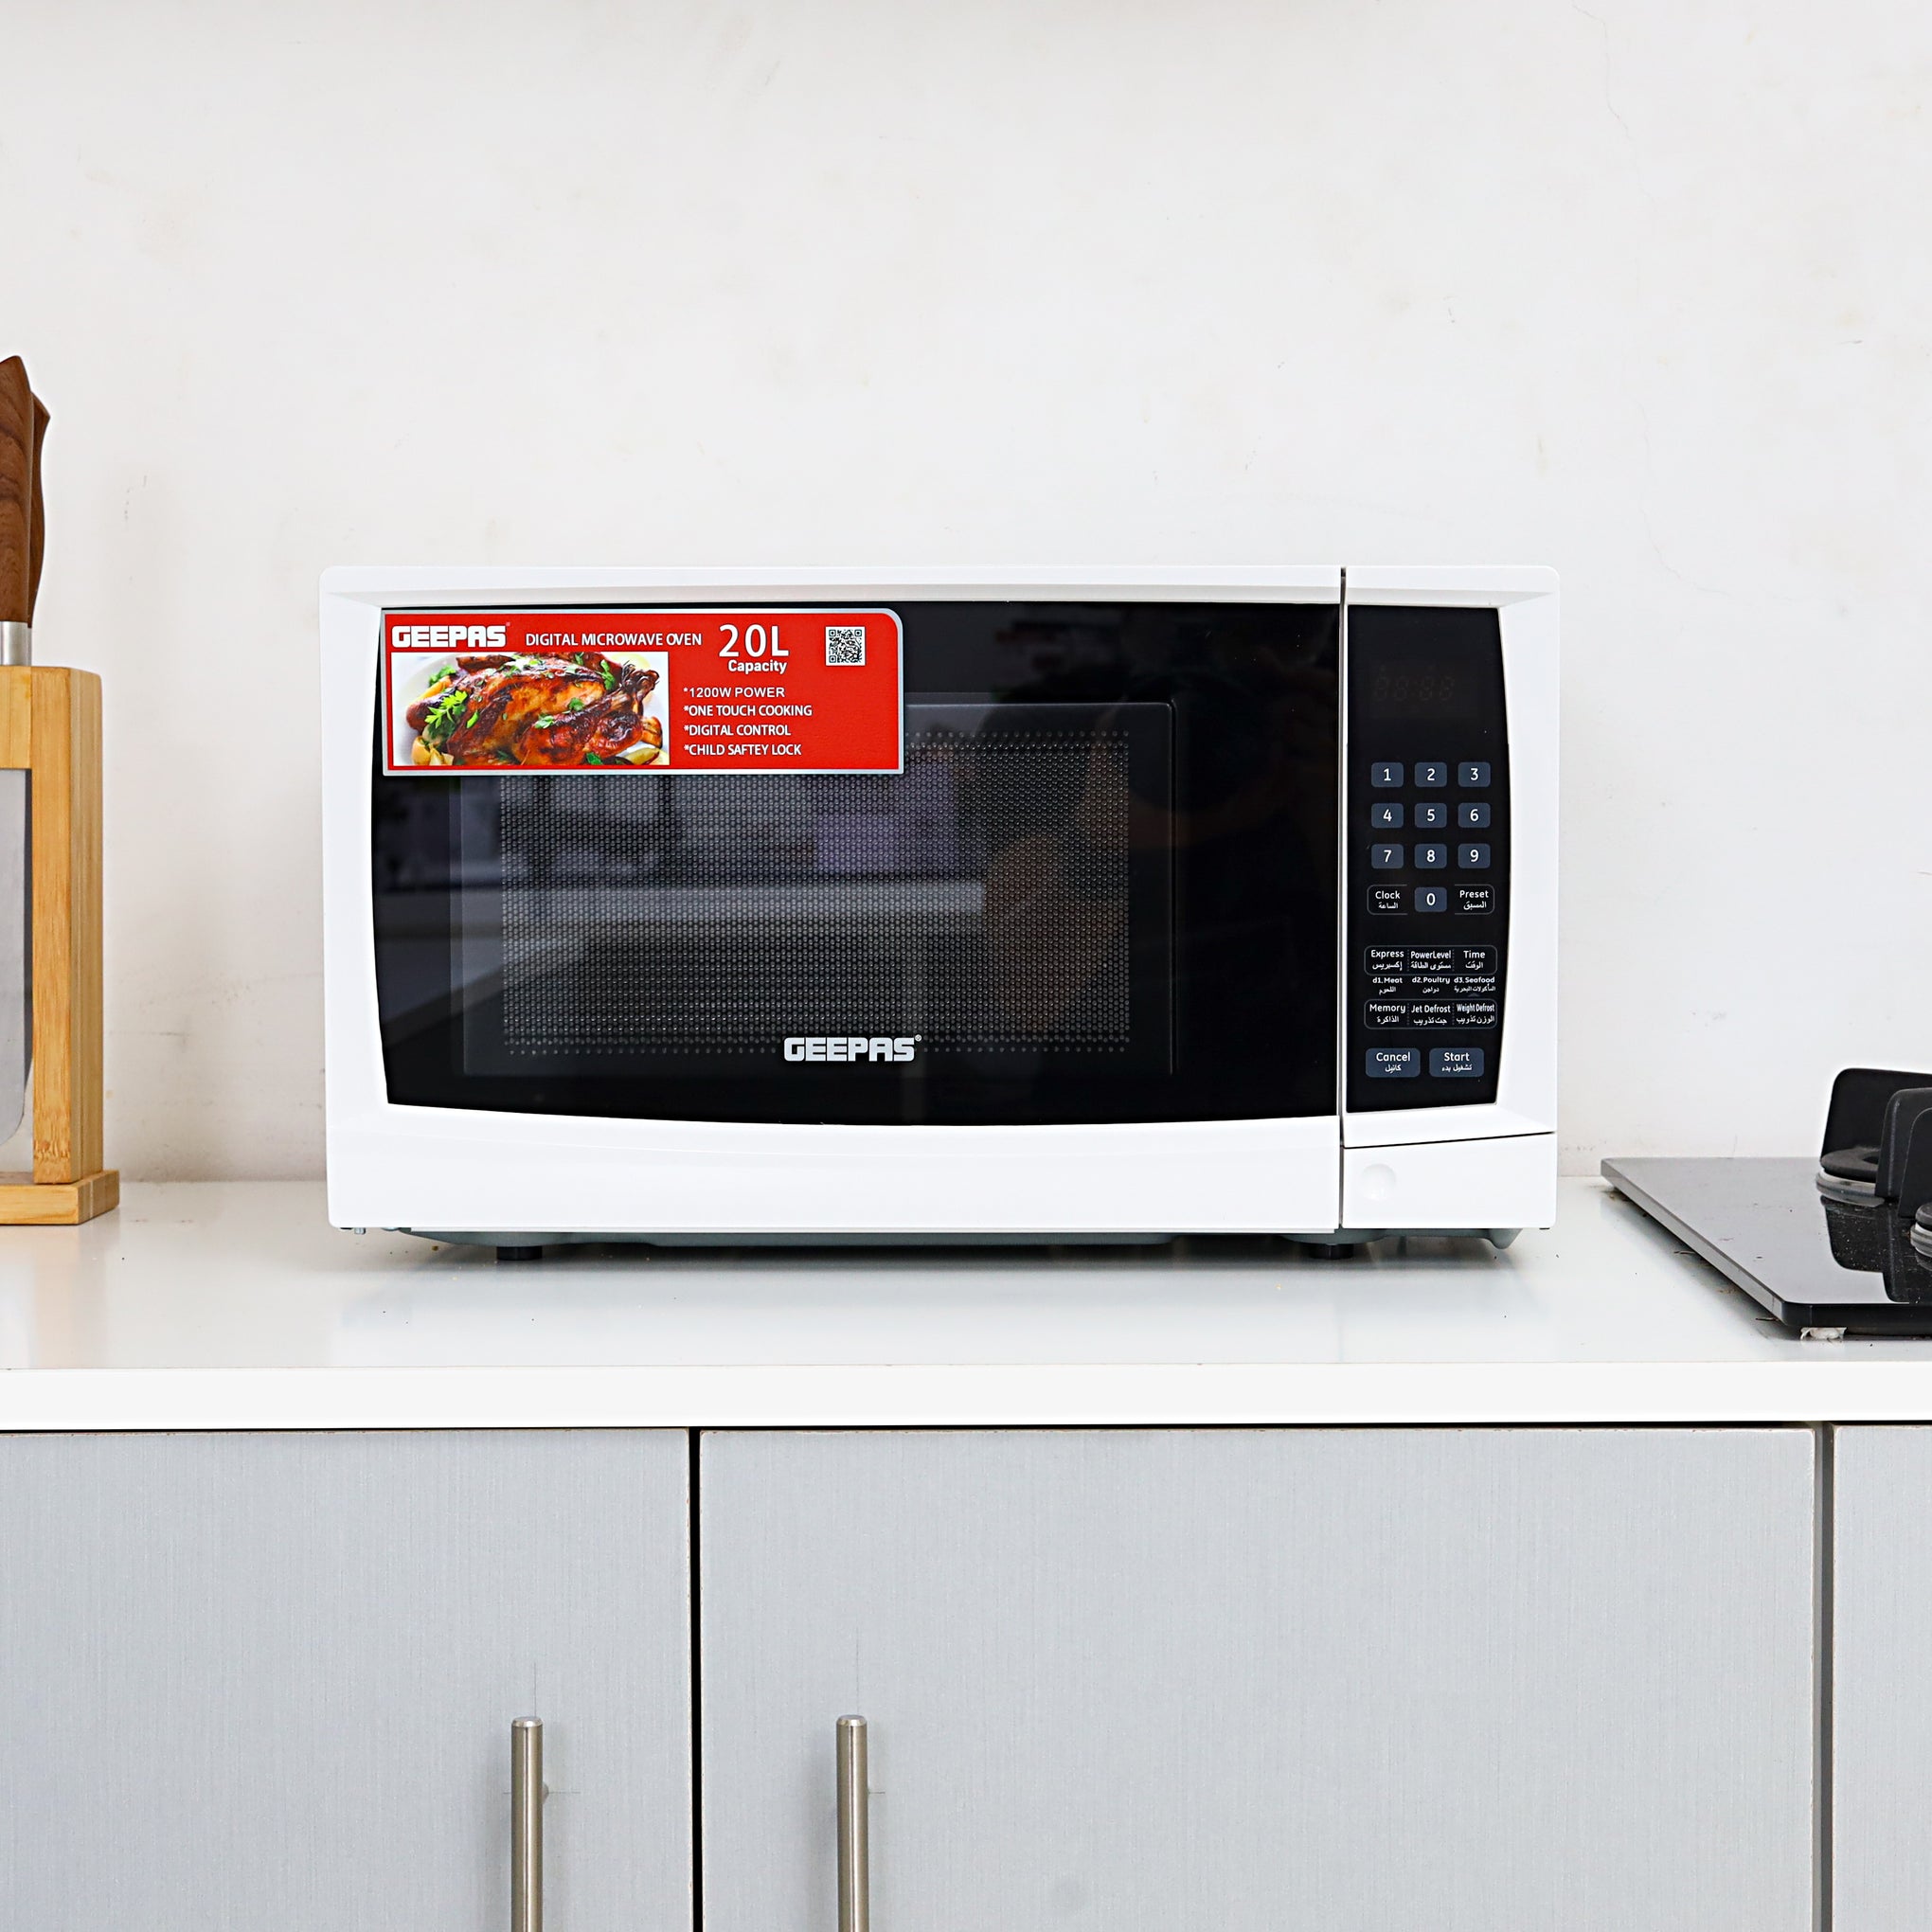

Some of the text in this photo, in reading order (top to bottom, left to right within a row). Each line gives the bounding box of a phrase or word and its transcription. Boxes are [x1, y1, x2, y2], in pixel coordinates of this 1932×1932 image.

[392, 625, 507, 648] GEEPAS
[526, 633, 702, 646] DIGITAL MICROWAVE OVEN
[718, 623, 790, 657] 20L
[727, 658, 788, 675] Capacity
[734, 687, 786, 698] POWER
[715, 704, 756, 717] TOUCH
[759, 704, 813, 717] COOKING
[736, 723, 792, 737] CONTROL
[727, 742, 769, 756] SAFTEY
[771, 742, 802, 756] LOCK
[1383, 768, 1391, 781] 1
[1426, 768, 1436, 781] 2
[1470, 768, 1478, 781] 3
[1383, 809, 1392, 822] 4
[1426, 809, 1436, 822] 5
[1470, 809, 1479, 822] 6
[1384, 850, 1392, 863] 7
[1426, 850, 1436, 863] 8
[1470, 850, 1479, 863] 9
[1375, 890, 1401, 900] Clock
[1426, 893, 1436, 906] 0
[1459, 889, 1489, 899] Preset
[1370, 949, 1404, 961] Express
[1463, 950, 1486, 958] Time
[1369, 1003, 1406, 1013] Memory
[1411, 1004, 1451, 1013] Jet Defrost
[1456, 1003, 1495, 1014] Weight Defrost
[783, 1037, 915, 1062] GEEPAS
[1376, 1051, 1411, 1062] Cancel
[1443, 1052, 1470, 1062] Start
